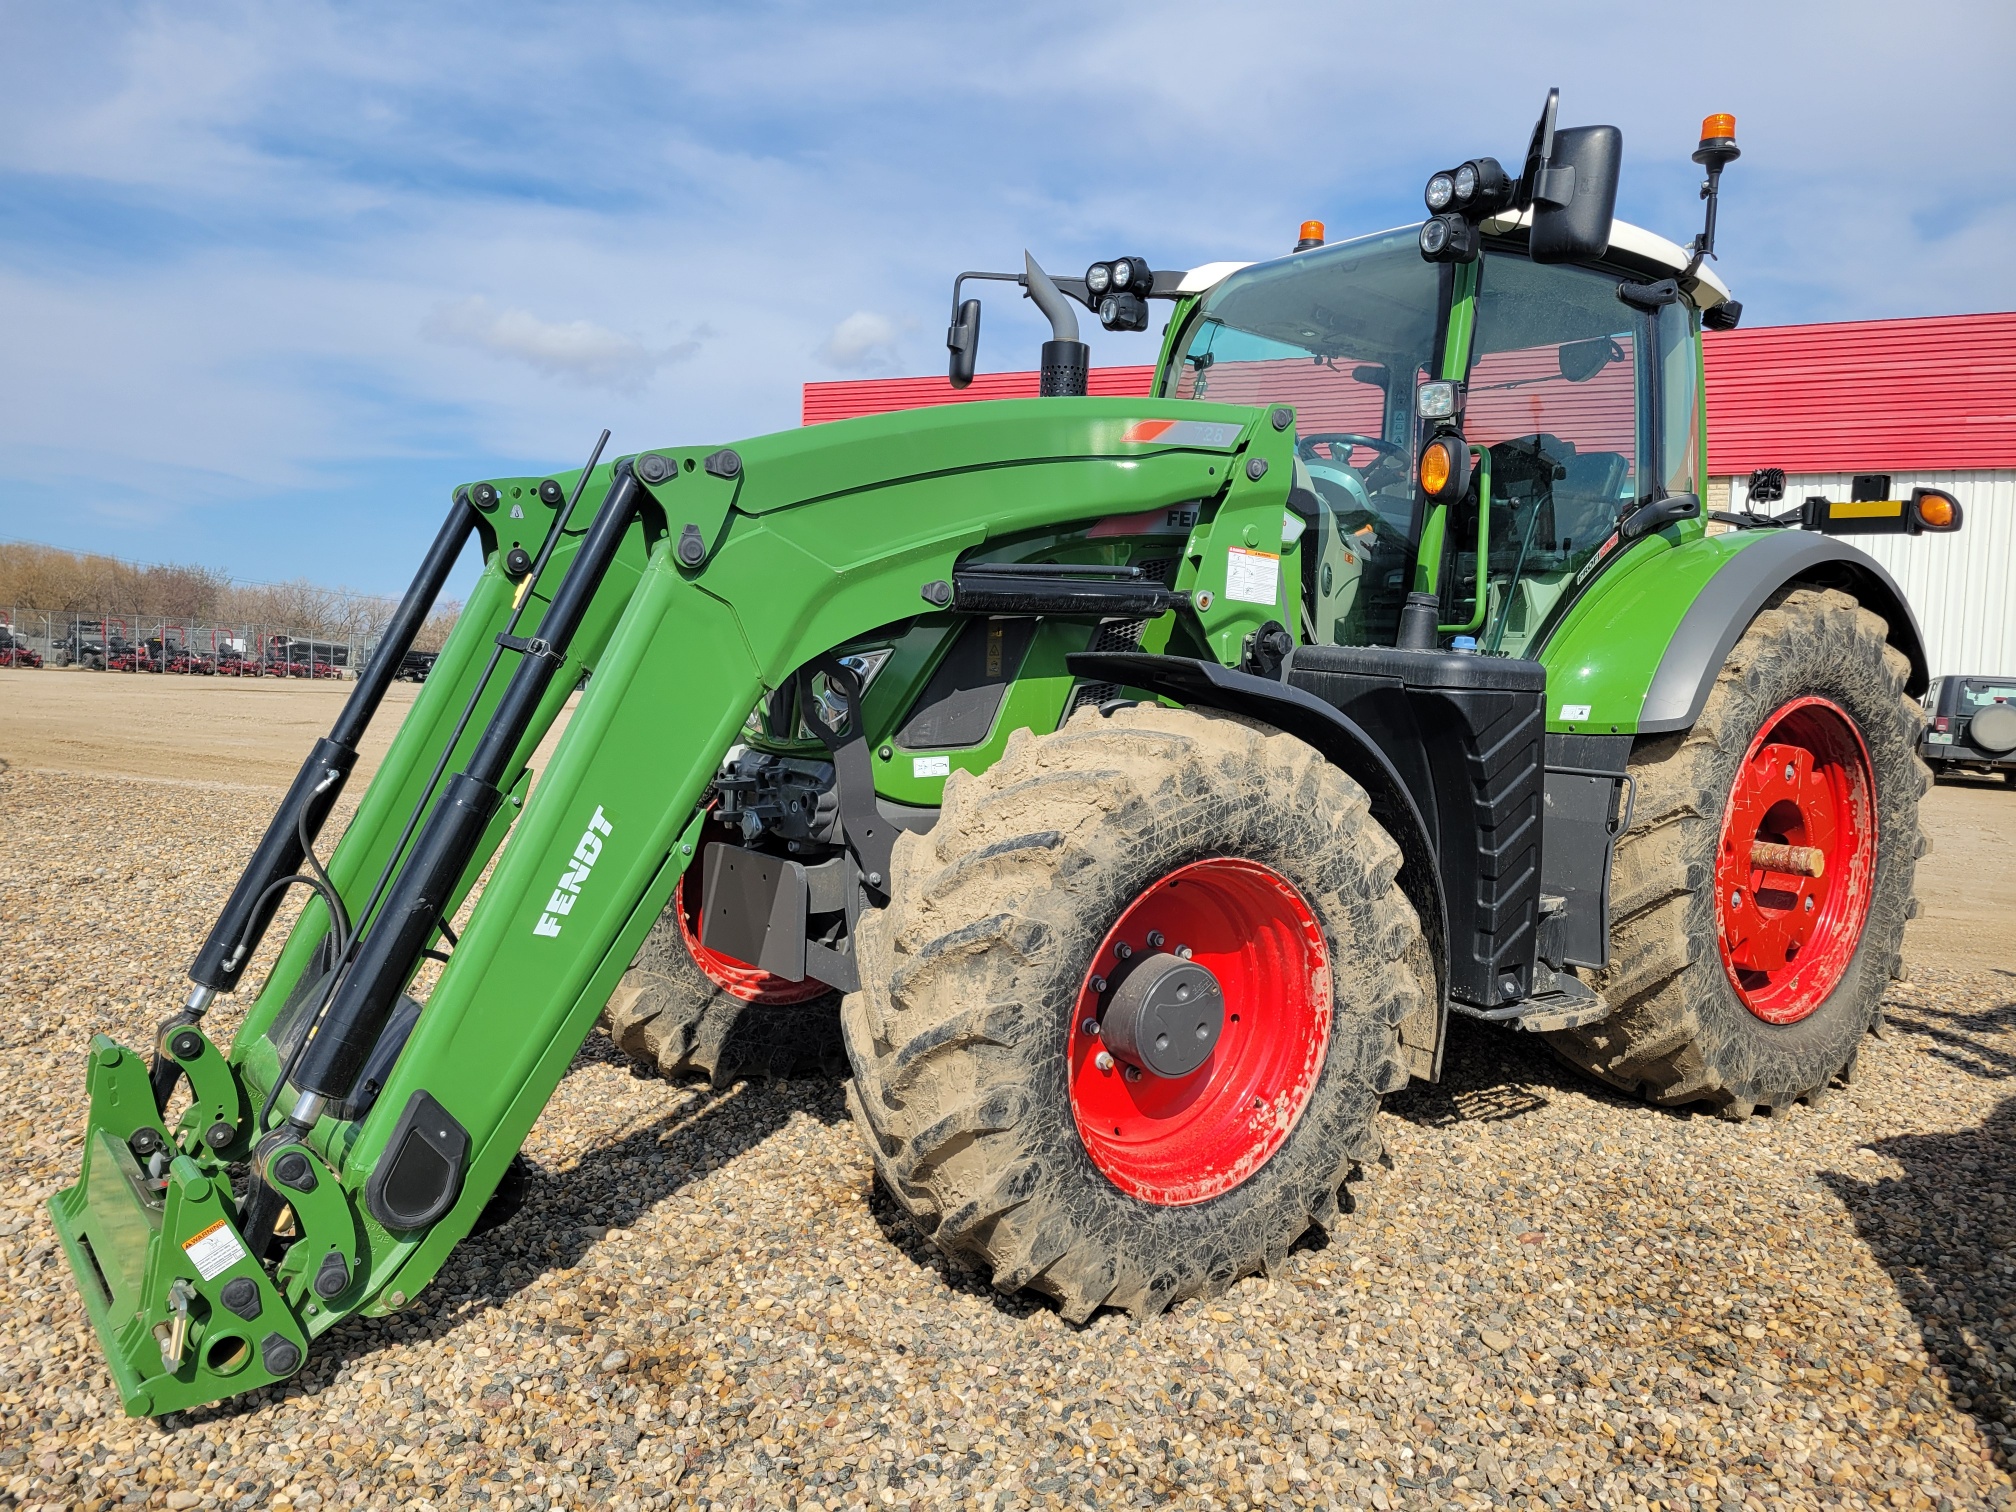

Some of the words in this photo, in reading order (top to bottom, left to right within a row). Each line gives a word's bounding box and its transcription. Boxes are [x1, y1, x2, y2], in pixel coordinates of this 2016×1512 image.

[1194, 426, 1225, 443] 728
[532, 804, 614, 938] FENDT
[190, 1220, 225, 1244] WARNING
